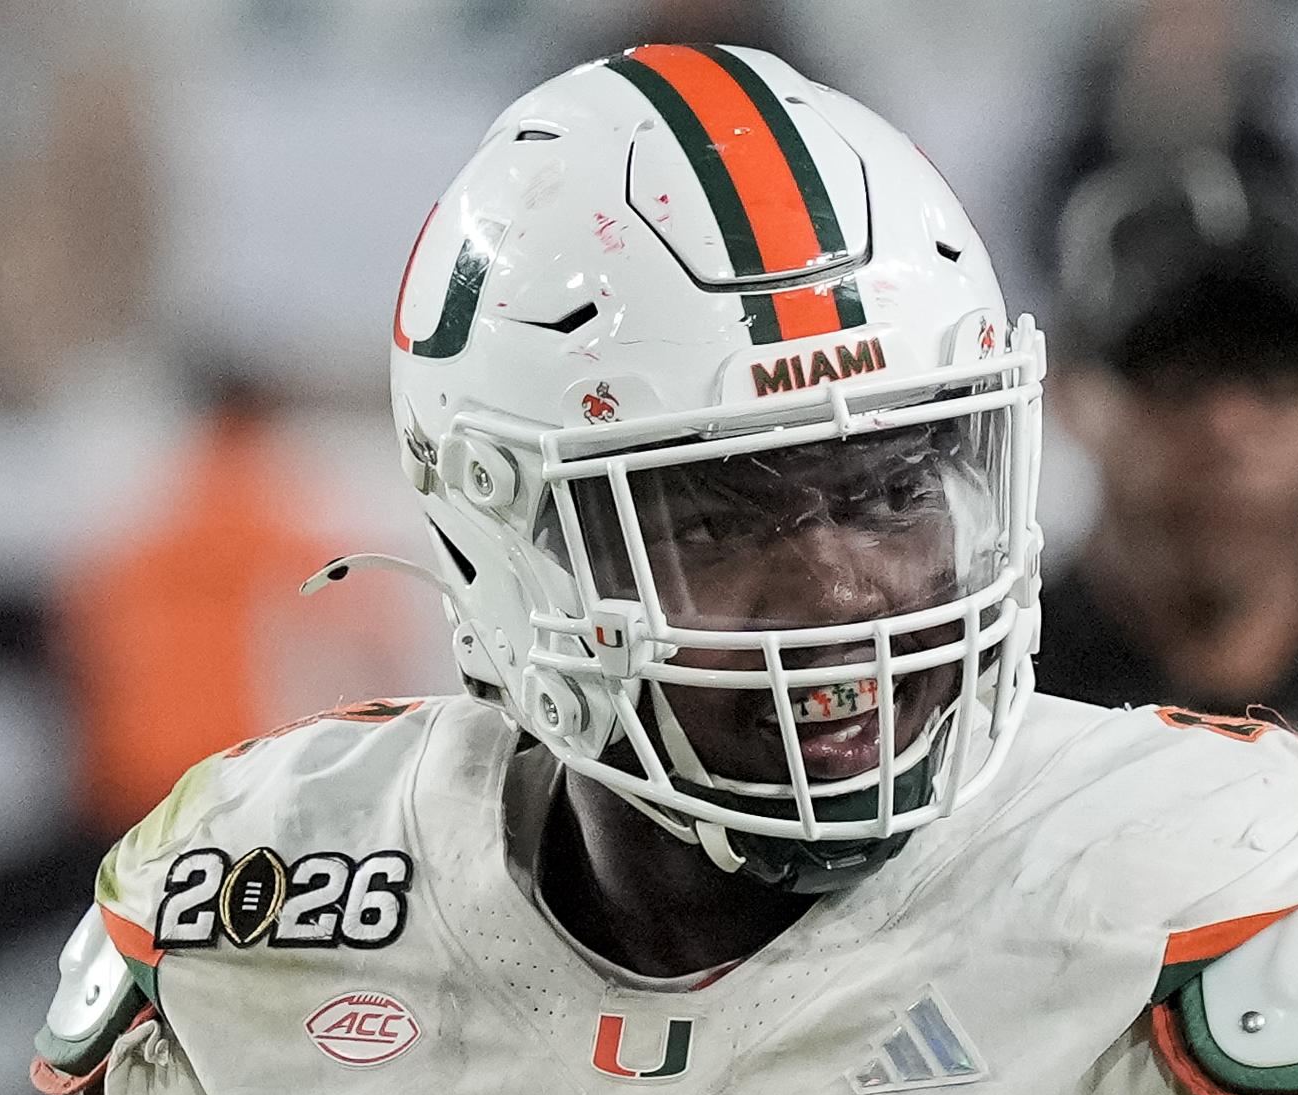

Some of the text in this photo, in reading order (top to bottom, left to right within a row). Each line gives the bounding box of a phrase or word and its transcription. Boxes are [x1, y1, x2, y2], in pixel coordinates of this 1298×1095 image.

[750, 337, 886, 397] MIAMI
[595, 625, 623, 648] U
[322, 1011, 405, 1038] ACC
[592, 1012, 694, 1079] U
